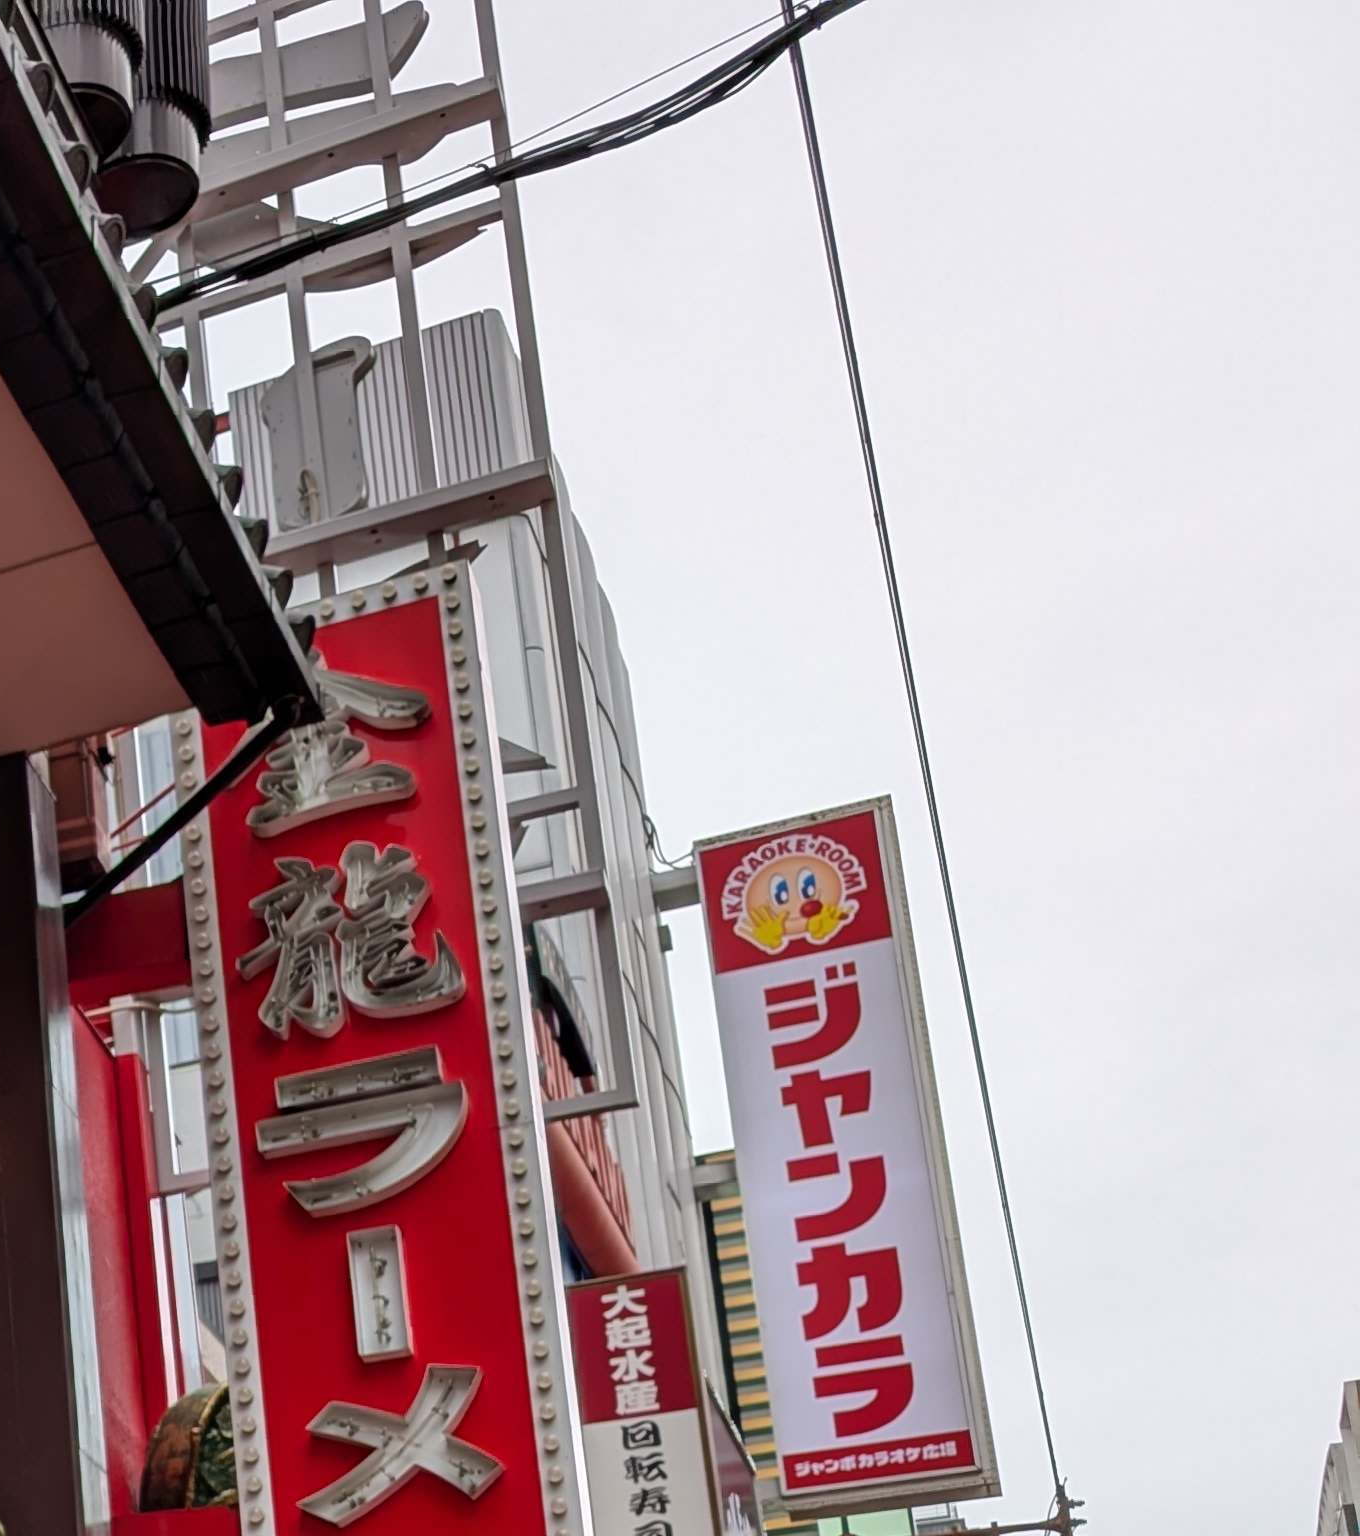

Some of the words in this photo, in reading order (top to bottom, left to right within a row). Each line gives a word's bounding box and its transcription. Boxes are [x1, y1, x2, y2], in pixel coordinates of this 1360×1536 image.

[764, 962, 916, 1439] ジャンカラ
[601, 1285, 660, 1417] 大起水産
[794, 1440, 958, 1478] ジャンボカラオケ広場
